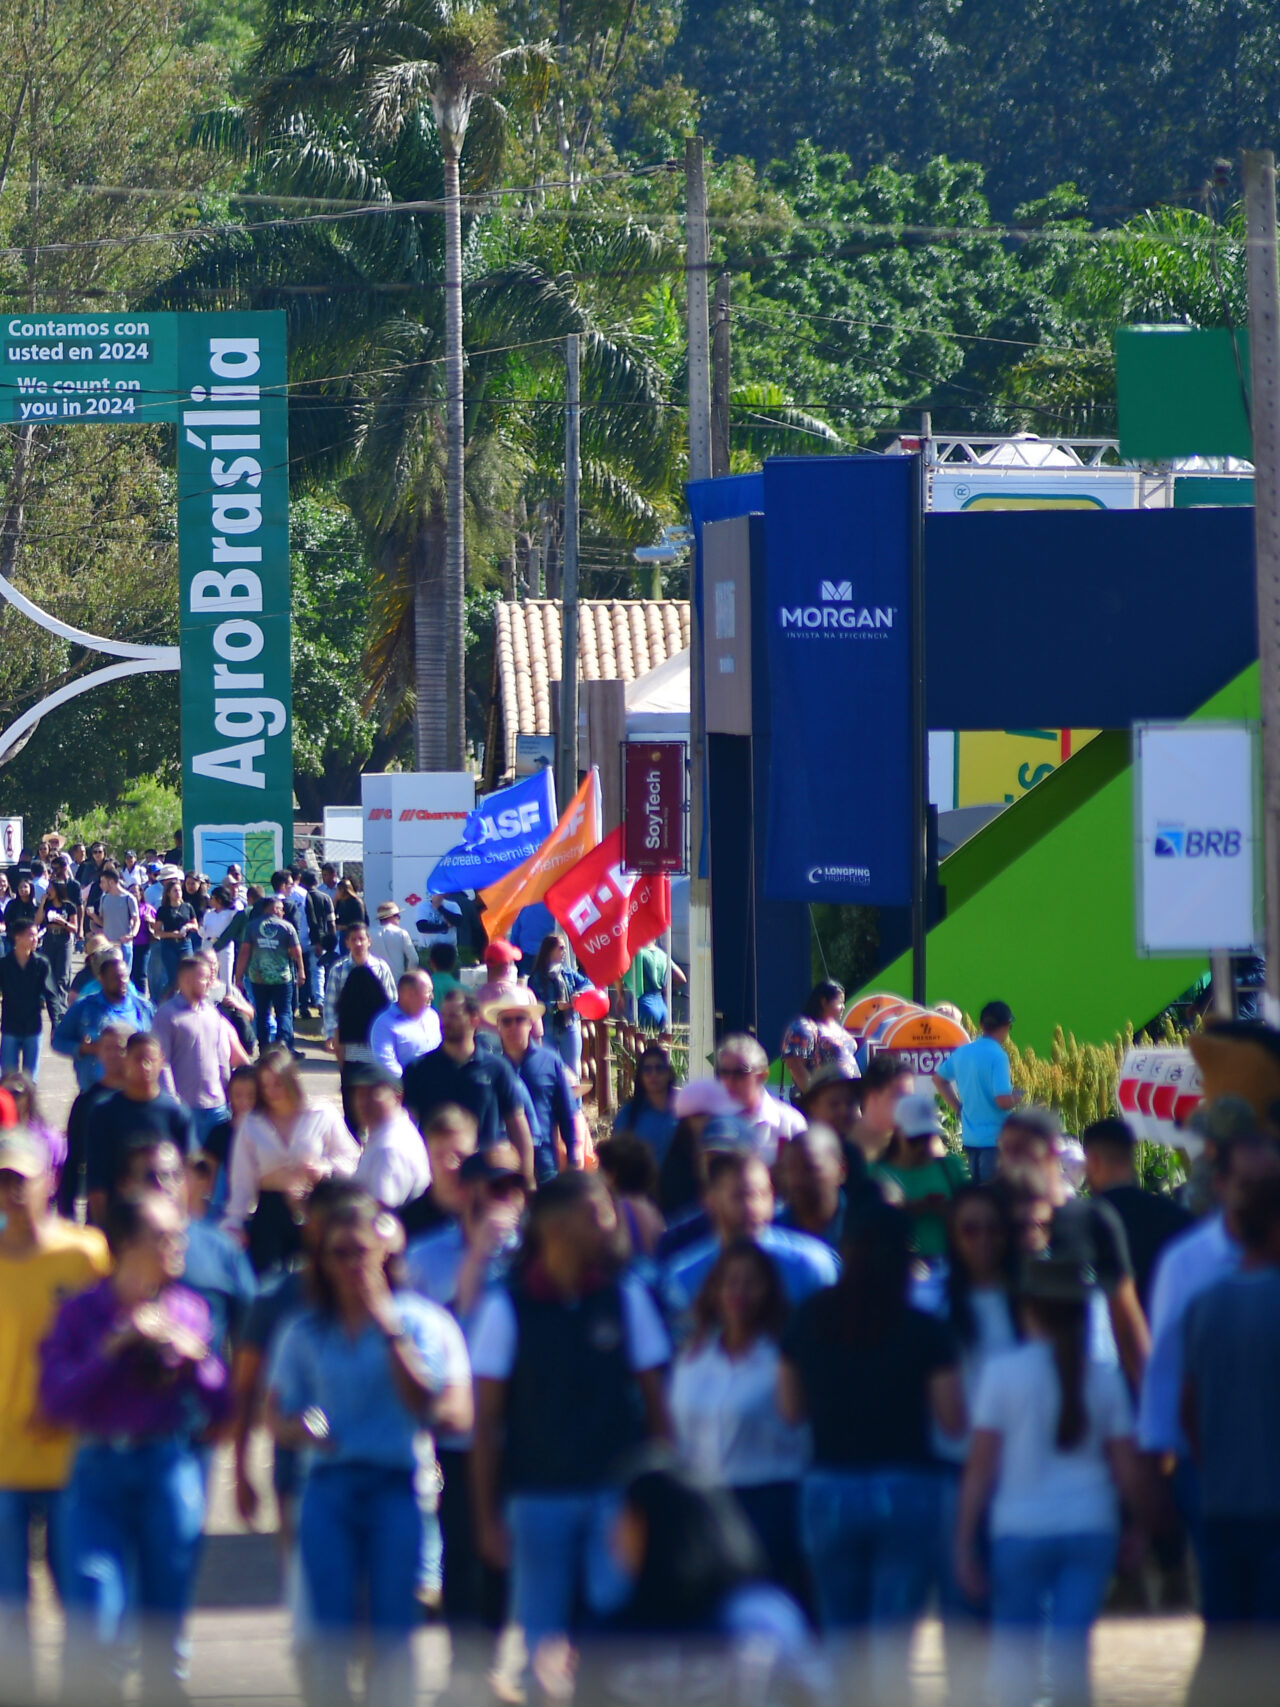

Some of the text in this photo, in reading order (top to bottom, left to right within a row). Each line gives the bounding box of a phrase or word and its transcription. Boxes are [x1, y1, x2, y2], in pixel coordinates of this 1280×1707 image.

[8, 320, 150, 337] Contamos con
[8, 342, 149, 360] usted en 2024
[17, 377, 141, 394] We count on
[20, 398, 136, 419] you in 2024
[183, 338, 287, 789] AgroBrasília
[782, 607, 893, 628] MORGAN
[646, 771, 663, 850] SoyTech
[477, 802, 540, 846] ASF
[1186, 829, 1242, 857] BRB
[452, 855, 482, 867] create
[825, 867, 870, 877] LONGPING
[584, 933, 611, 955] We
